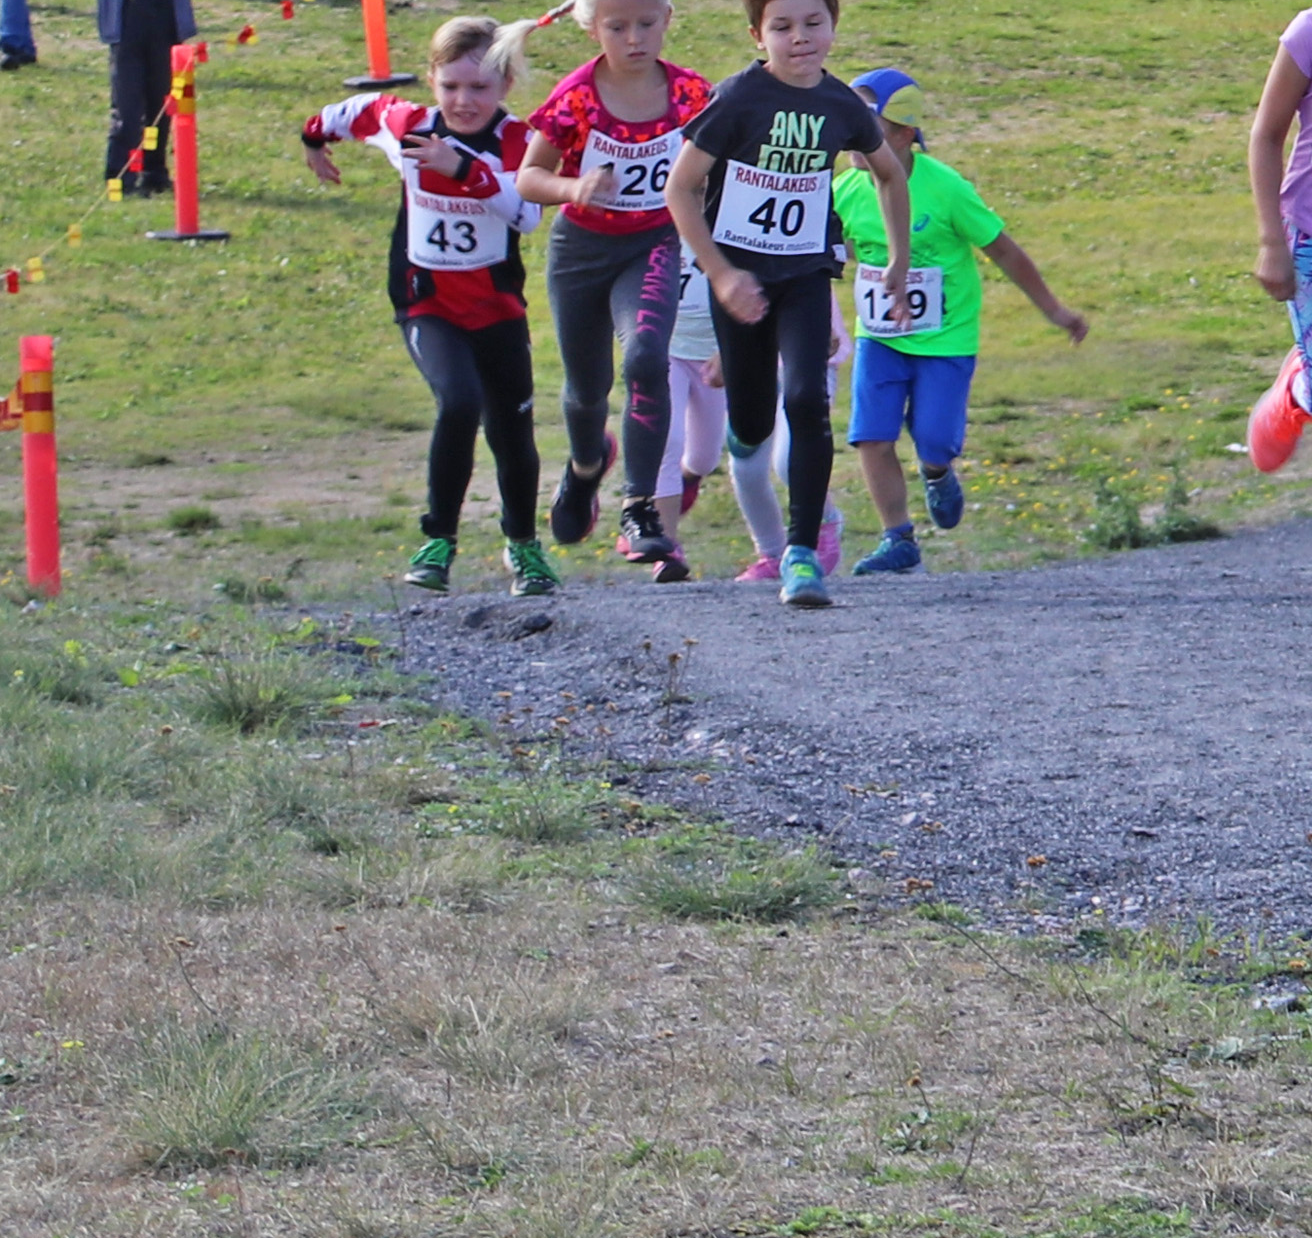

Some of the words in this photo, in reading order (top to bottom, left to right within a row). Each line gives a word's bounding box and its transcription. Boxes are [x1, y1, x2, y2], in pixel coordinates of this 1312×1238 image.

[769, 111, 826, 149] ANY
[593, 136, 669, 160] RANTALAKEUS
[734, 166, 818, 193] RANTALAKEUS
[748, 197, 805, 237] 40
[427, 219, 478, 253] 43
[723, 229, 785, 252] Rantalakeus
